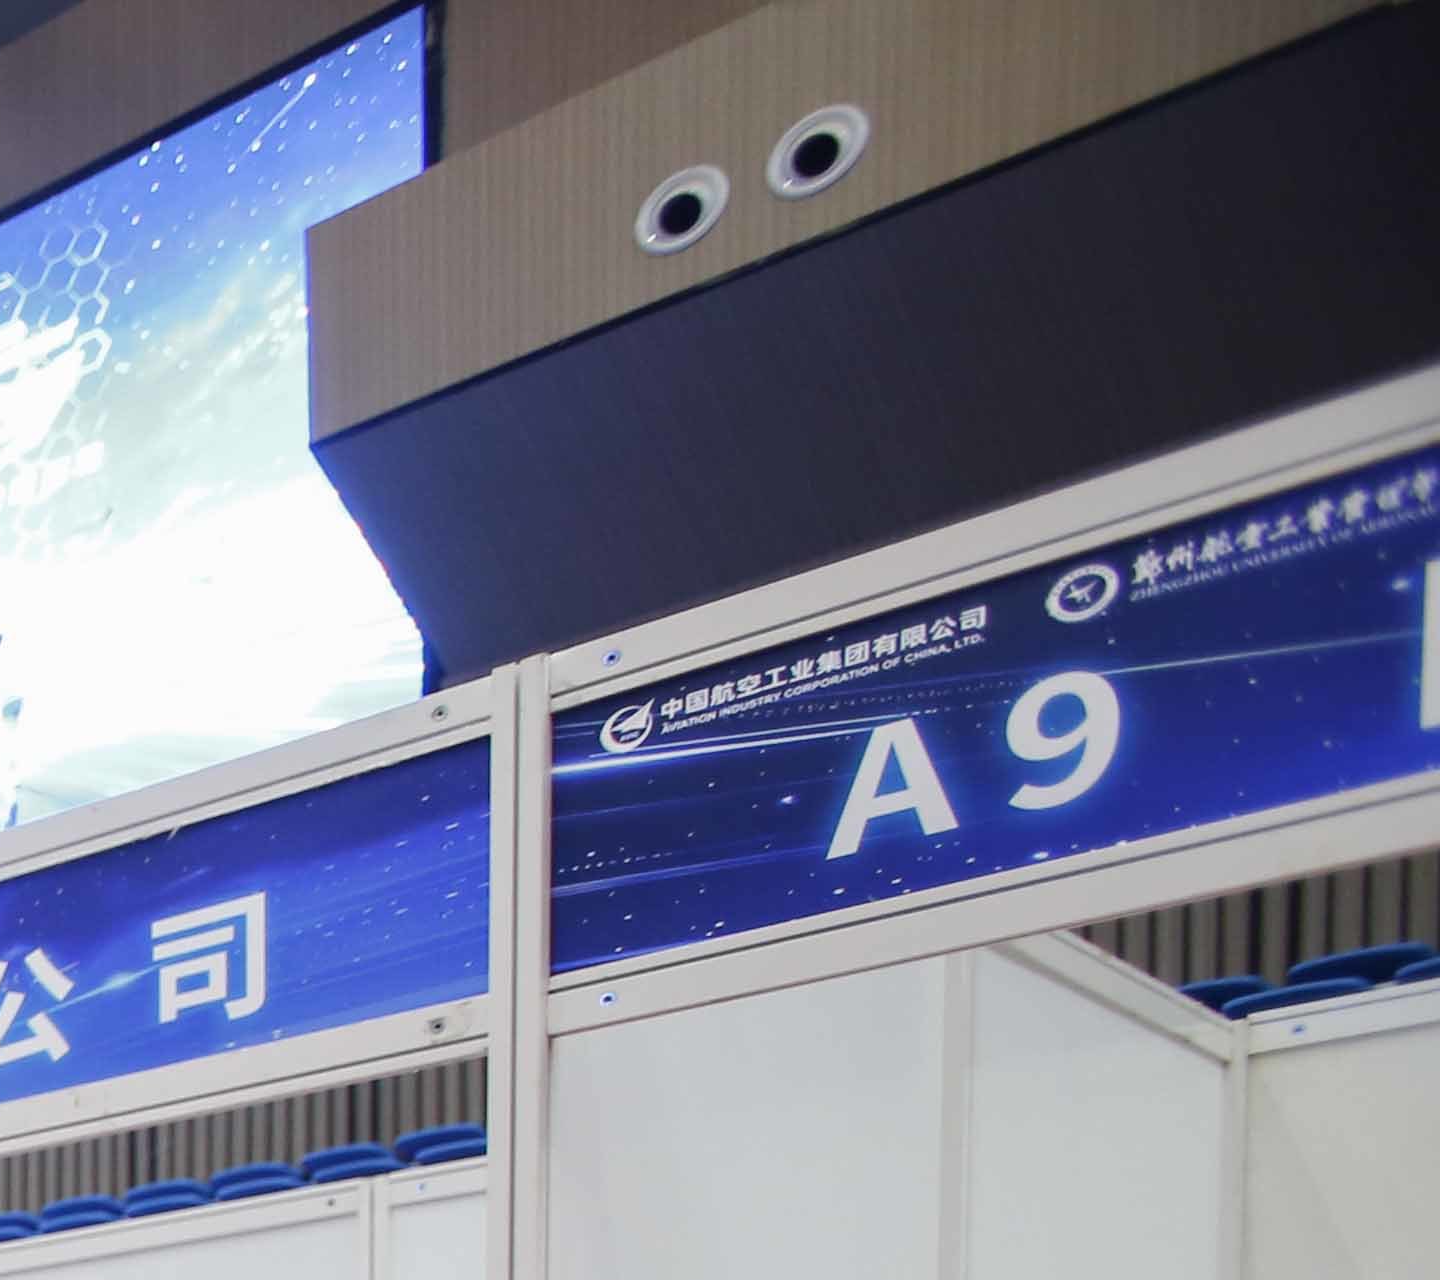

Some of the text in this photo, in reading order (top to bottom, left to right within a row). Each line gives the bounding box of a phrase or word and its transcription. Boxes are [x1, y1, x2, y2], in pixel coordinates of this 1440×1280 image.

[660, 605, 988, 720] 中国航空工业集团有限公司
[661, 706, 717, 735] AVIATION
[719, 691, 782, 719] INDUSTRY
[784, 664, 880, 700] CORPORATION
[881, 656, 901, 671] OF
[954, 633, 985, 651] LTD.
